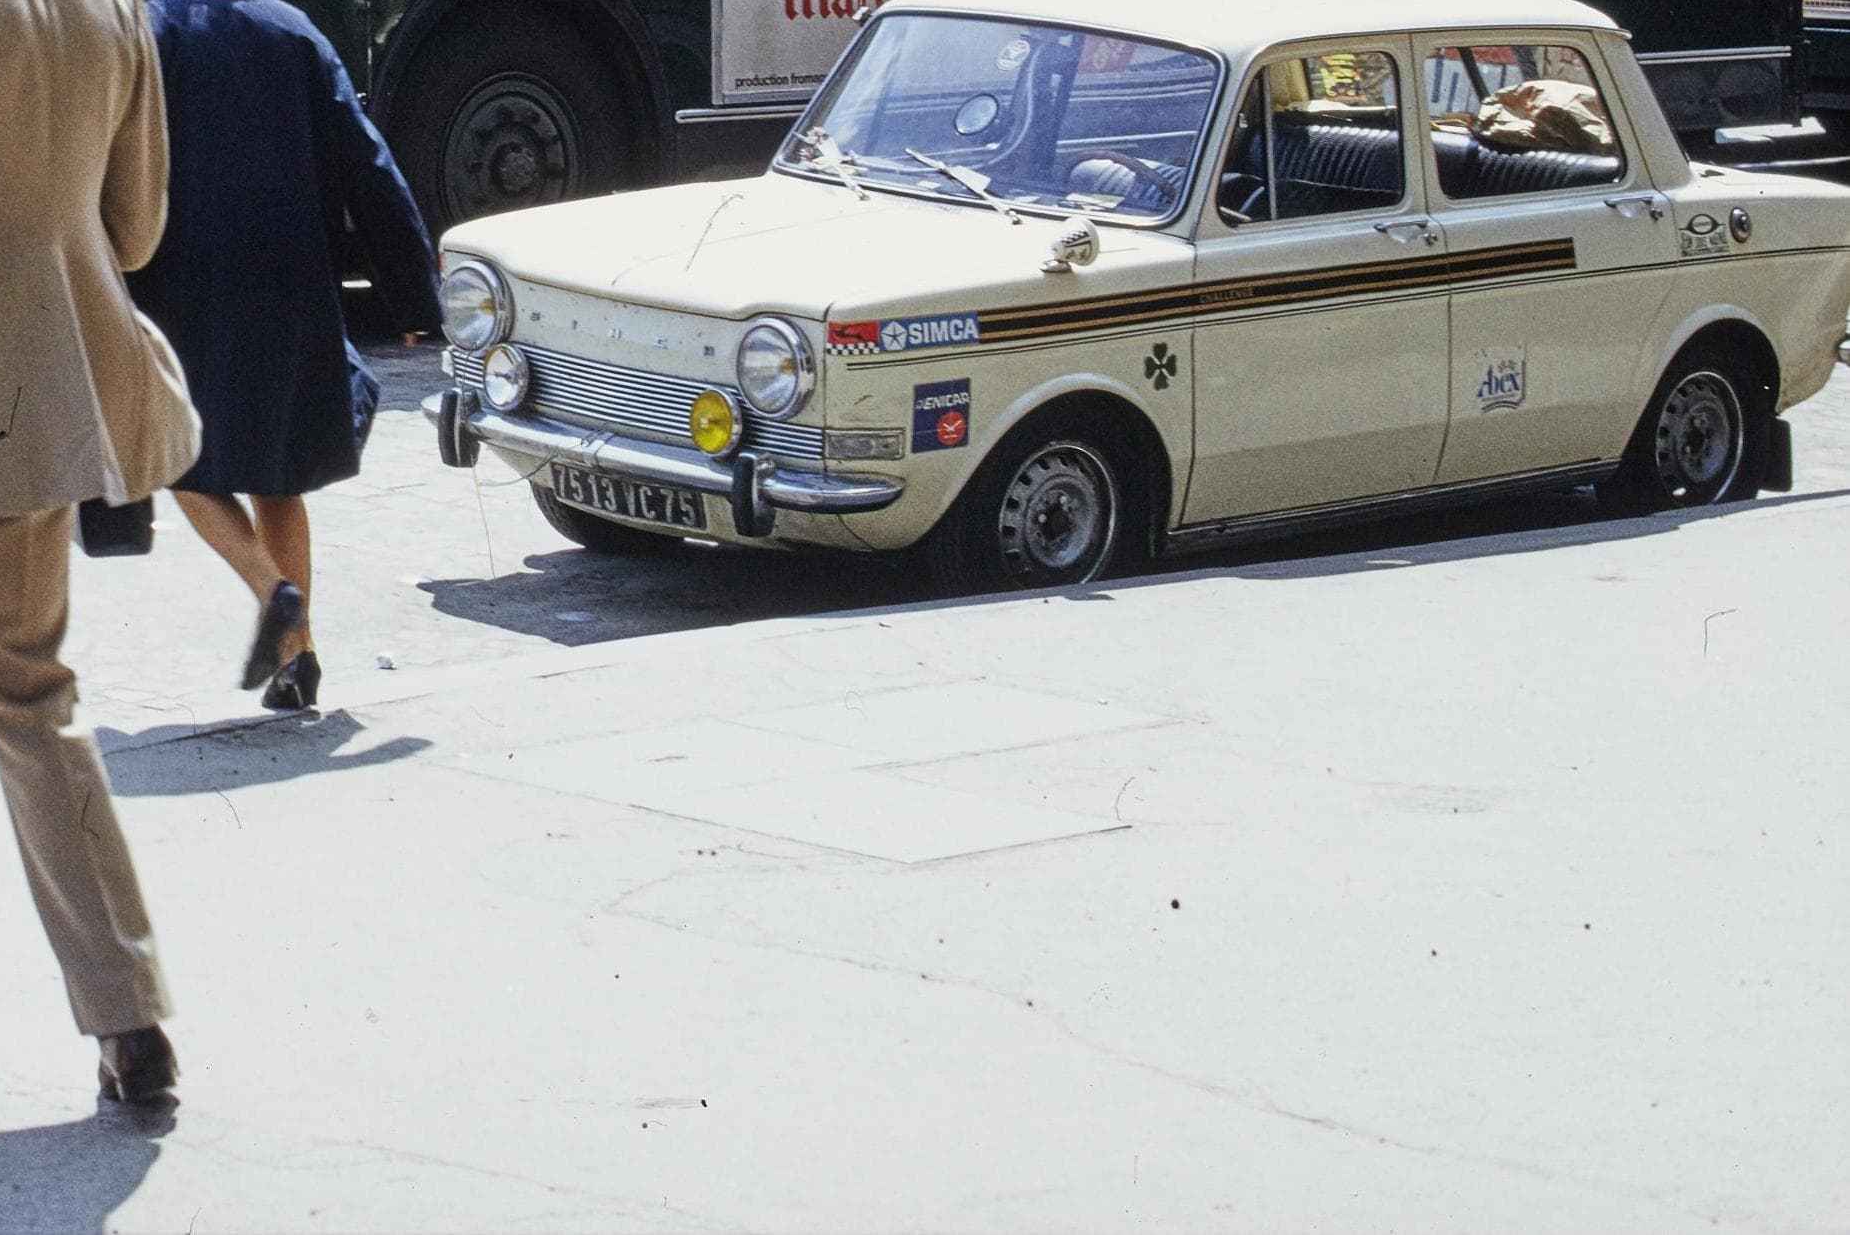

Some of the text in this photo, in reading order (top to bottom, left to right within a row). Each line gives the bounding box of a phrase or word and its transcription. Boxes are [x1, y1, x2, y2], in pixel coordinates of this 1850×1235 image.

[735, 73, 789, 92] production
[908, 317, 980, 345] SIMCA
[660, 487, 696, 527] 75
